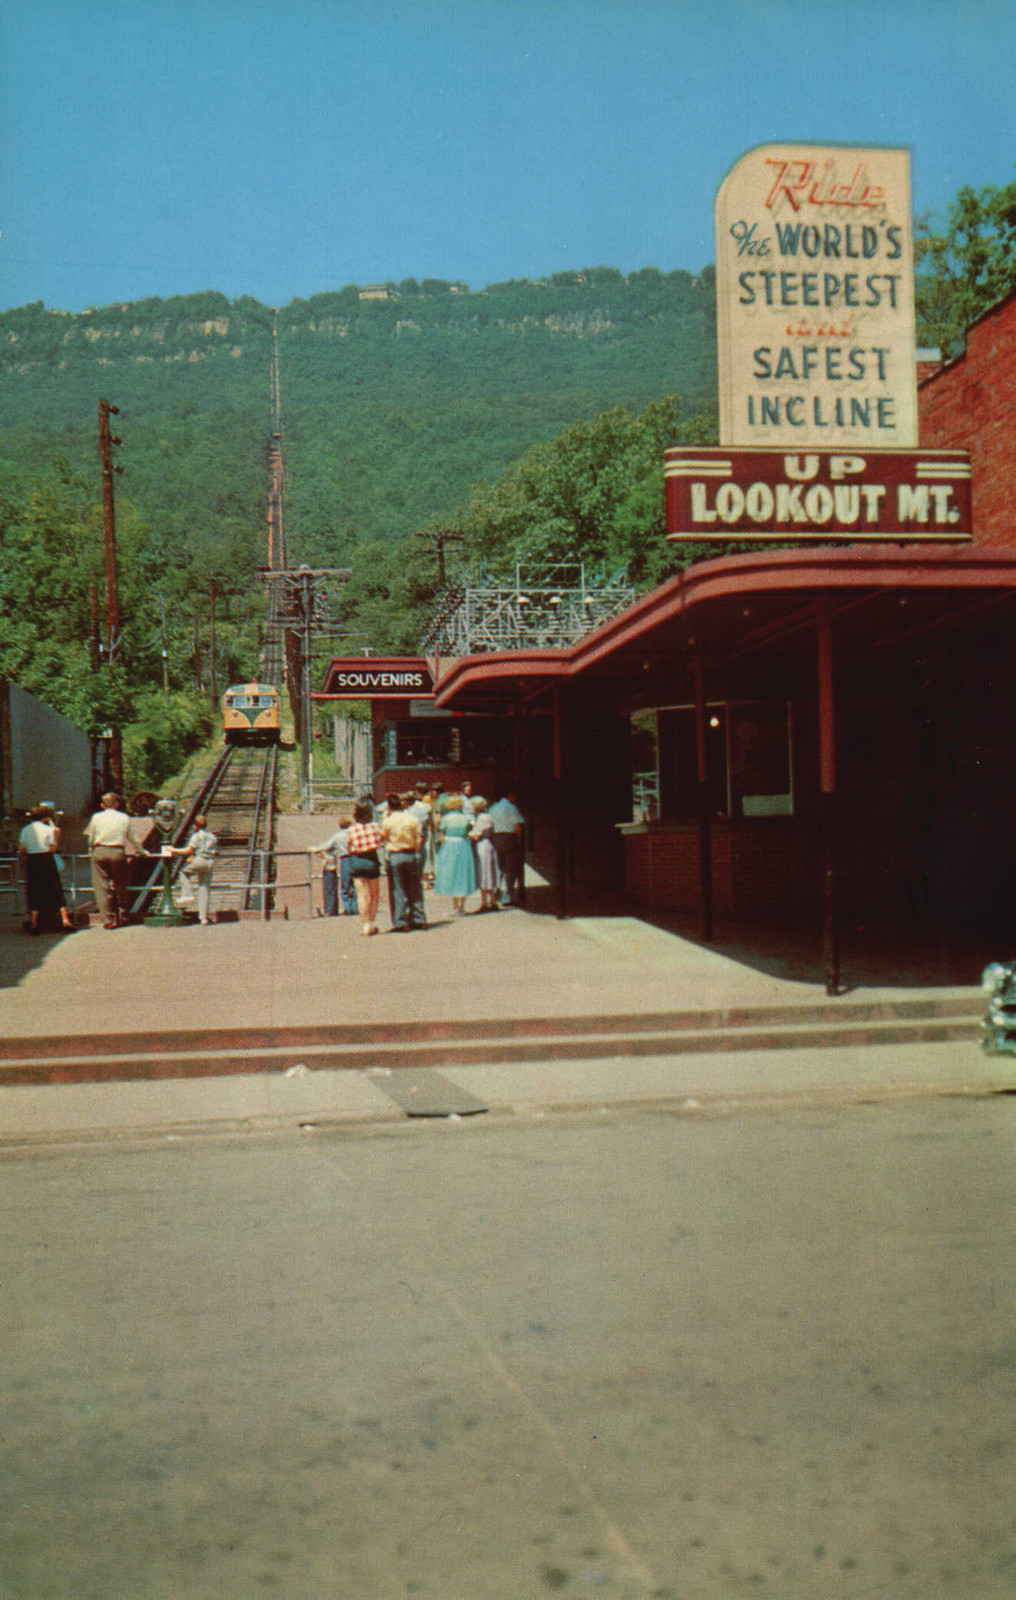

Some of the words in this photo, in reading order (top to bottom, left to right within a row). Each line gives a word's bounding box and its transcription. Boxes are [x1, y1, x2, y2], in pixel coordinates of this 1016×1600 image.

[776, 221, 902, 260] WORLD'S
[738, 271, 902, 308] STEEPEST
[752, 346, 890, 382] SAFEST
[748, 395, 896, 430] INCLINE
[783, 454, 867, 480] UP
[690, 481, 887, 524] LOOKOUT
[897, 481, 960, 524] MT.
[338, 673, 422, 687] SOUVENIRS
